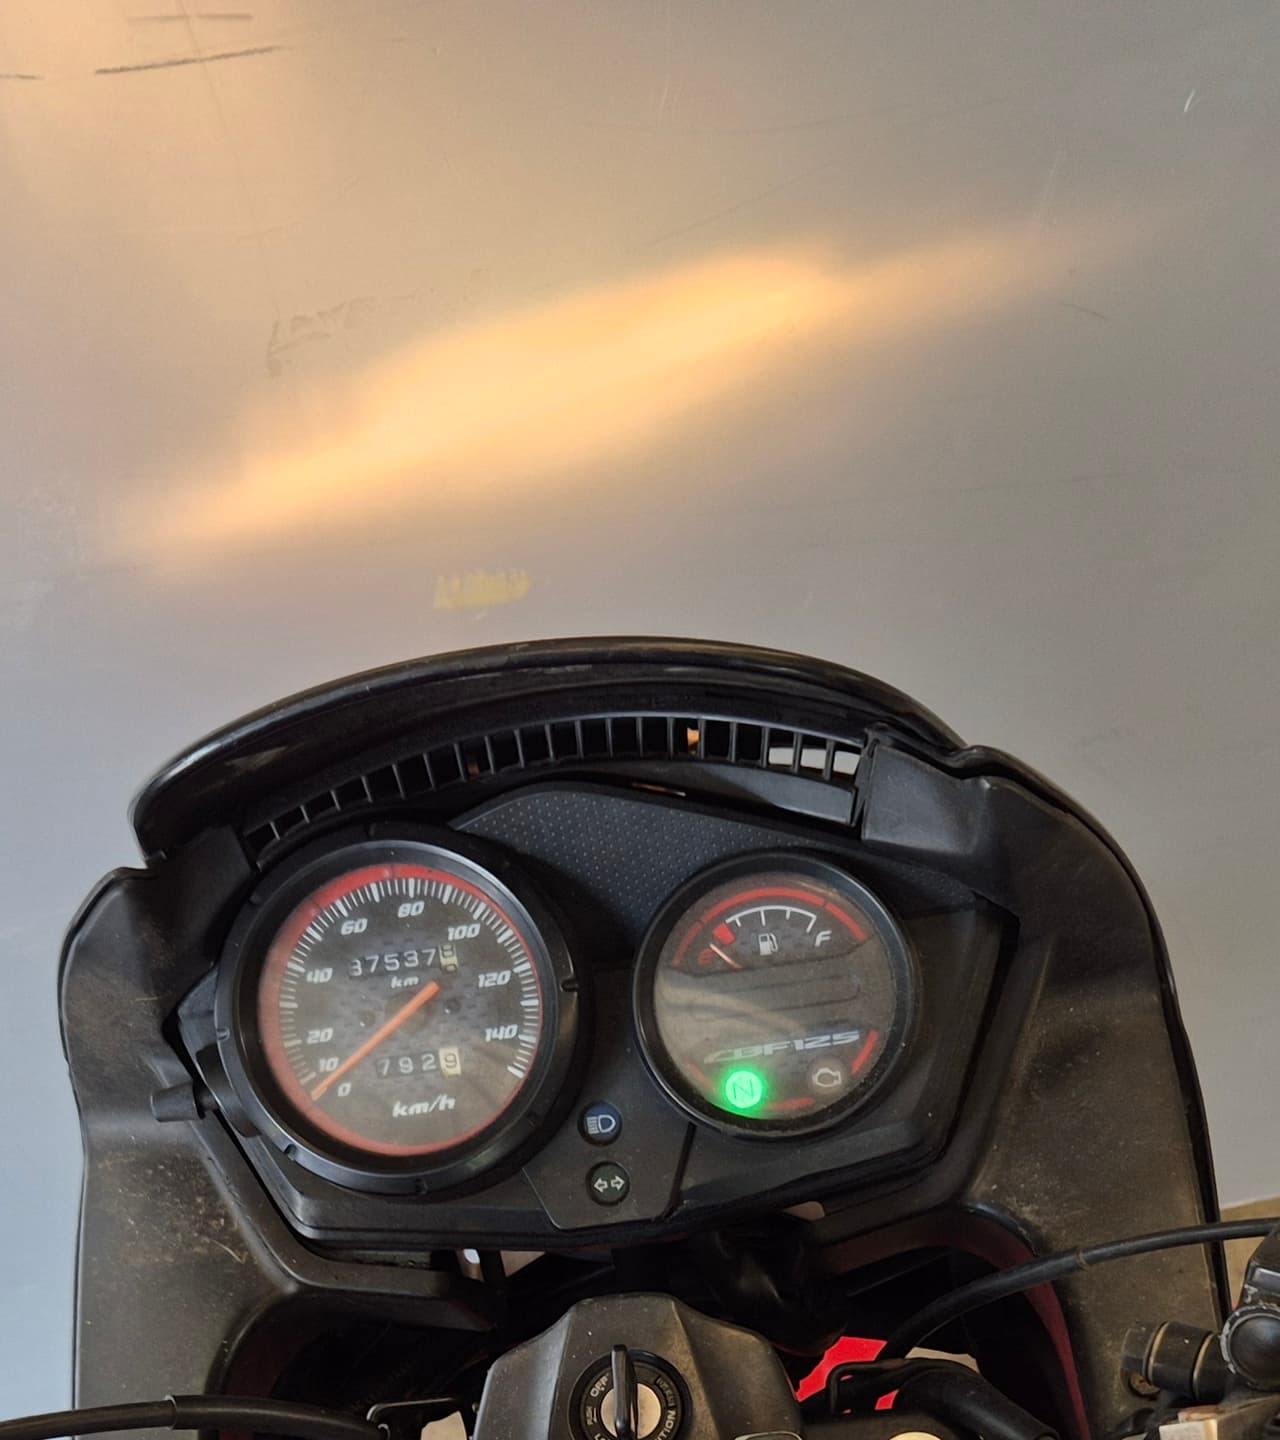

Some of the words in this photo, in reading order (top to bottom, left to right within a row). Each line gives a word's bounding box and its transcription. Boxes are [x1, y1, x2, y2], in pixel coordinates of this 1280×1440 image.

[398, 901, 425, 918] 80
[341, 918, 368, 935] 60
[447, 923, 481, 941] 100
[815, 930, 832, 947] F
[306, 967, 333, 984] 40
[391, 976, 419, 989] km
[478, 970, 512, 988] 120
[306, 1027, 333, 1044] 20
[485, 1024, 518, 1042] 140
[319, 1057, 339, 1072] 10
[337, 1083, 352, 1097] 0
[733, 1079, 754, 1100] N
[392, 1094, 456, 1118] km/h
